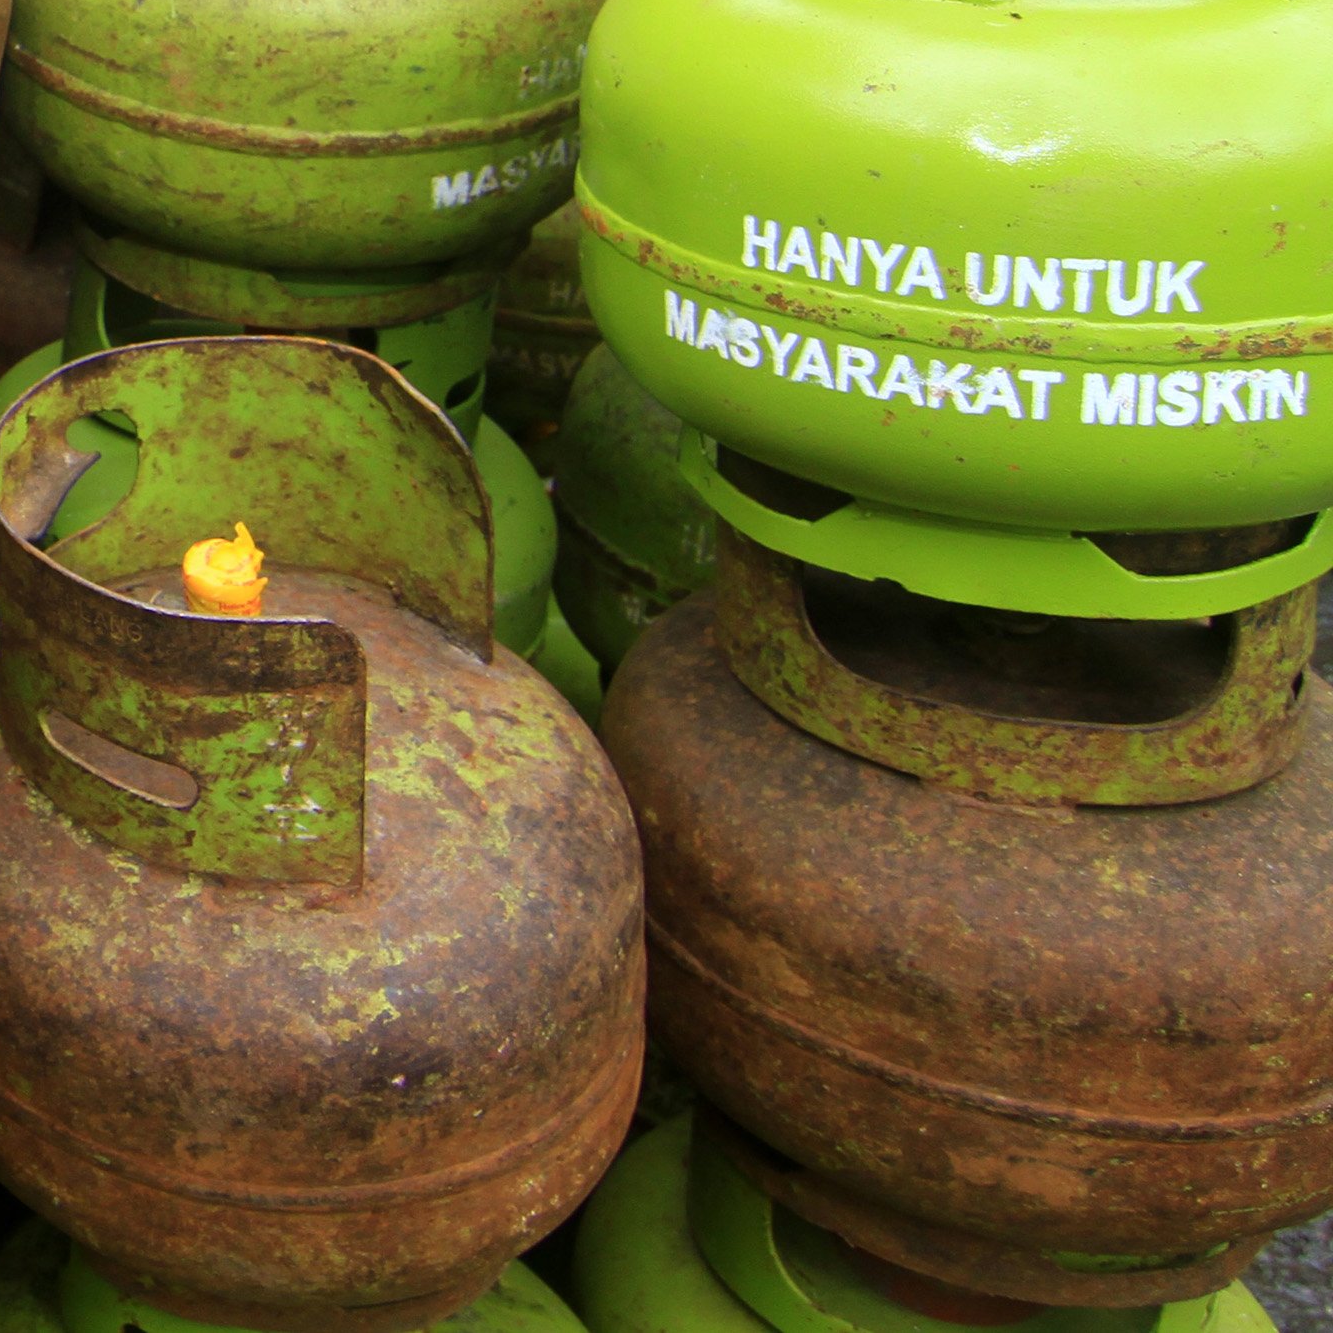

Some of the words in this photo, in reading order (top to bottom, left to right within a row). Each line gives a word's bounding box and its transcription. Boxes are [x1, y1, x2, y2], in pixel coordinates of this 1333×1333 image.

[741, 214, 947, 300] HANYA
[965, 251, 1207, 317] UNTUK
[664, 288, 1065, 421] MASYARAKAT
[1081, 368, 1309, 428] MISKIN
